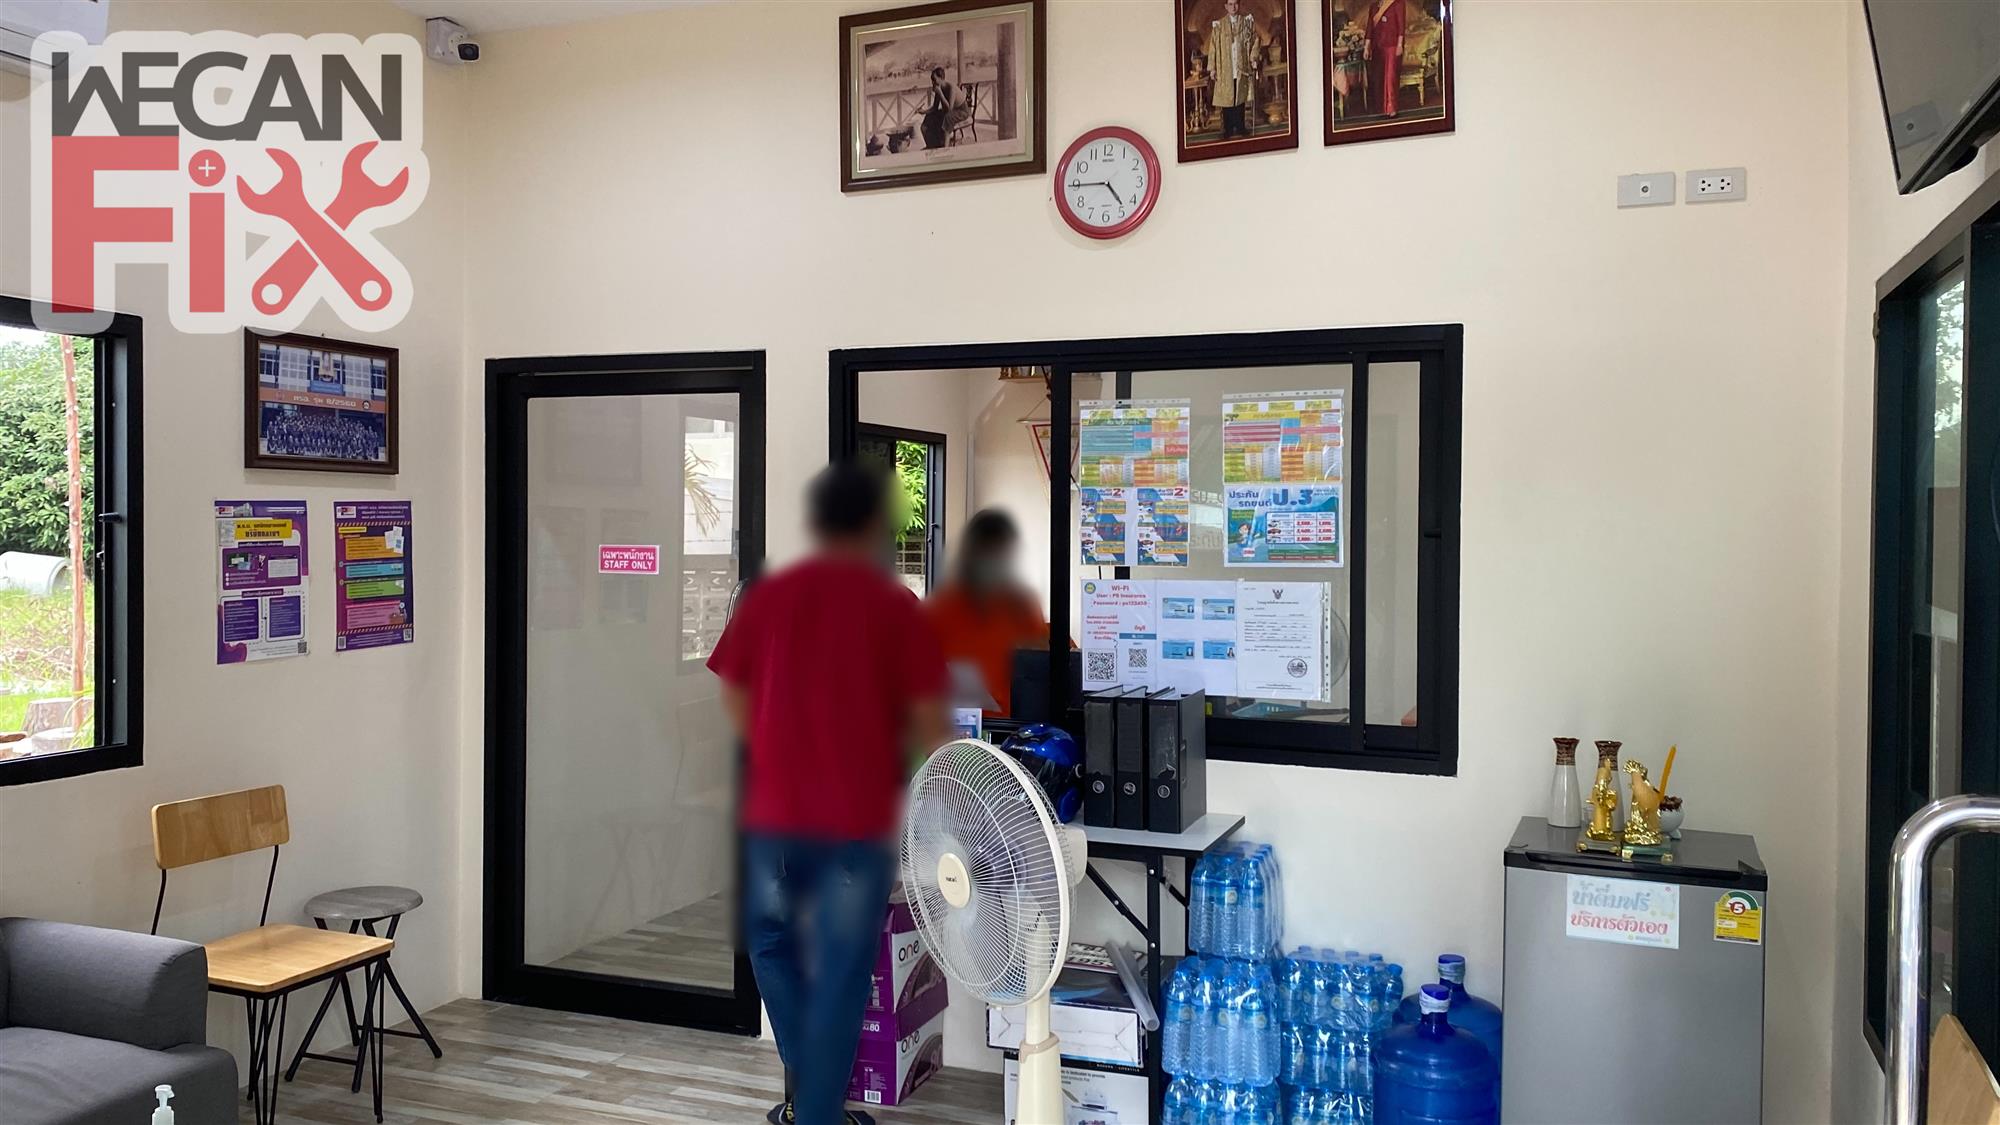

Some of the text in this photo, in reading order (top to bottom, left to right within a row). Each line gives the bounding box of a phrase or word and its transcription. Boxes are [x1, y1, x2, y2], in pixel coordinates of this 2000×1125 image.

[1090, 148, 1098, 161] 11
[1104, 144, 1114, 157] 12
[1076, 161, 1089, 175] 10
[1132, 158, 1140, 171] 2
[1072, 178, 1081, 191] 9
[1136, 175, 1144, 189] 3
[1076, 196, 1085, 208] 8
[1129, 193, 1137, 206] 4
[1088, 207, 1095, 220] 7
[1102, 210, 1110, 224] 6
[1118, 206, 1126, 219] 5
[1229, 490, 1259, 500] ประกัน
[602, 548, 655, 560] เฉพาะพนักงาน
[604, 560, 653, 570] STAFF ONLY
[1572, 880, 1651, 912] น้ำดื่มฟรี
[1733, 903, 1744, 914] 5
[1571, 910, 1668, 936] บริการตัวเอง
[898, 940, 920, 962] one
[870, 1023, 880, 1032] 80
[901, 1030, 921, 1054] one
